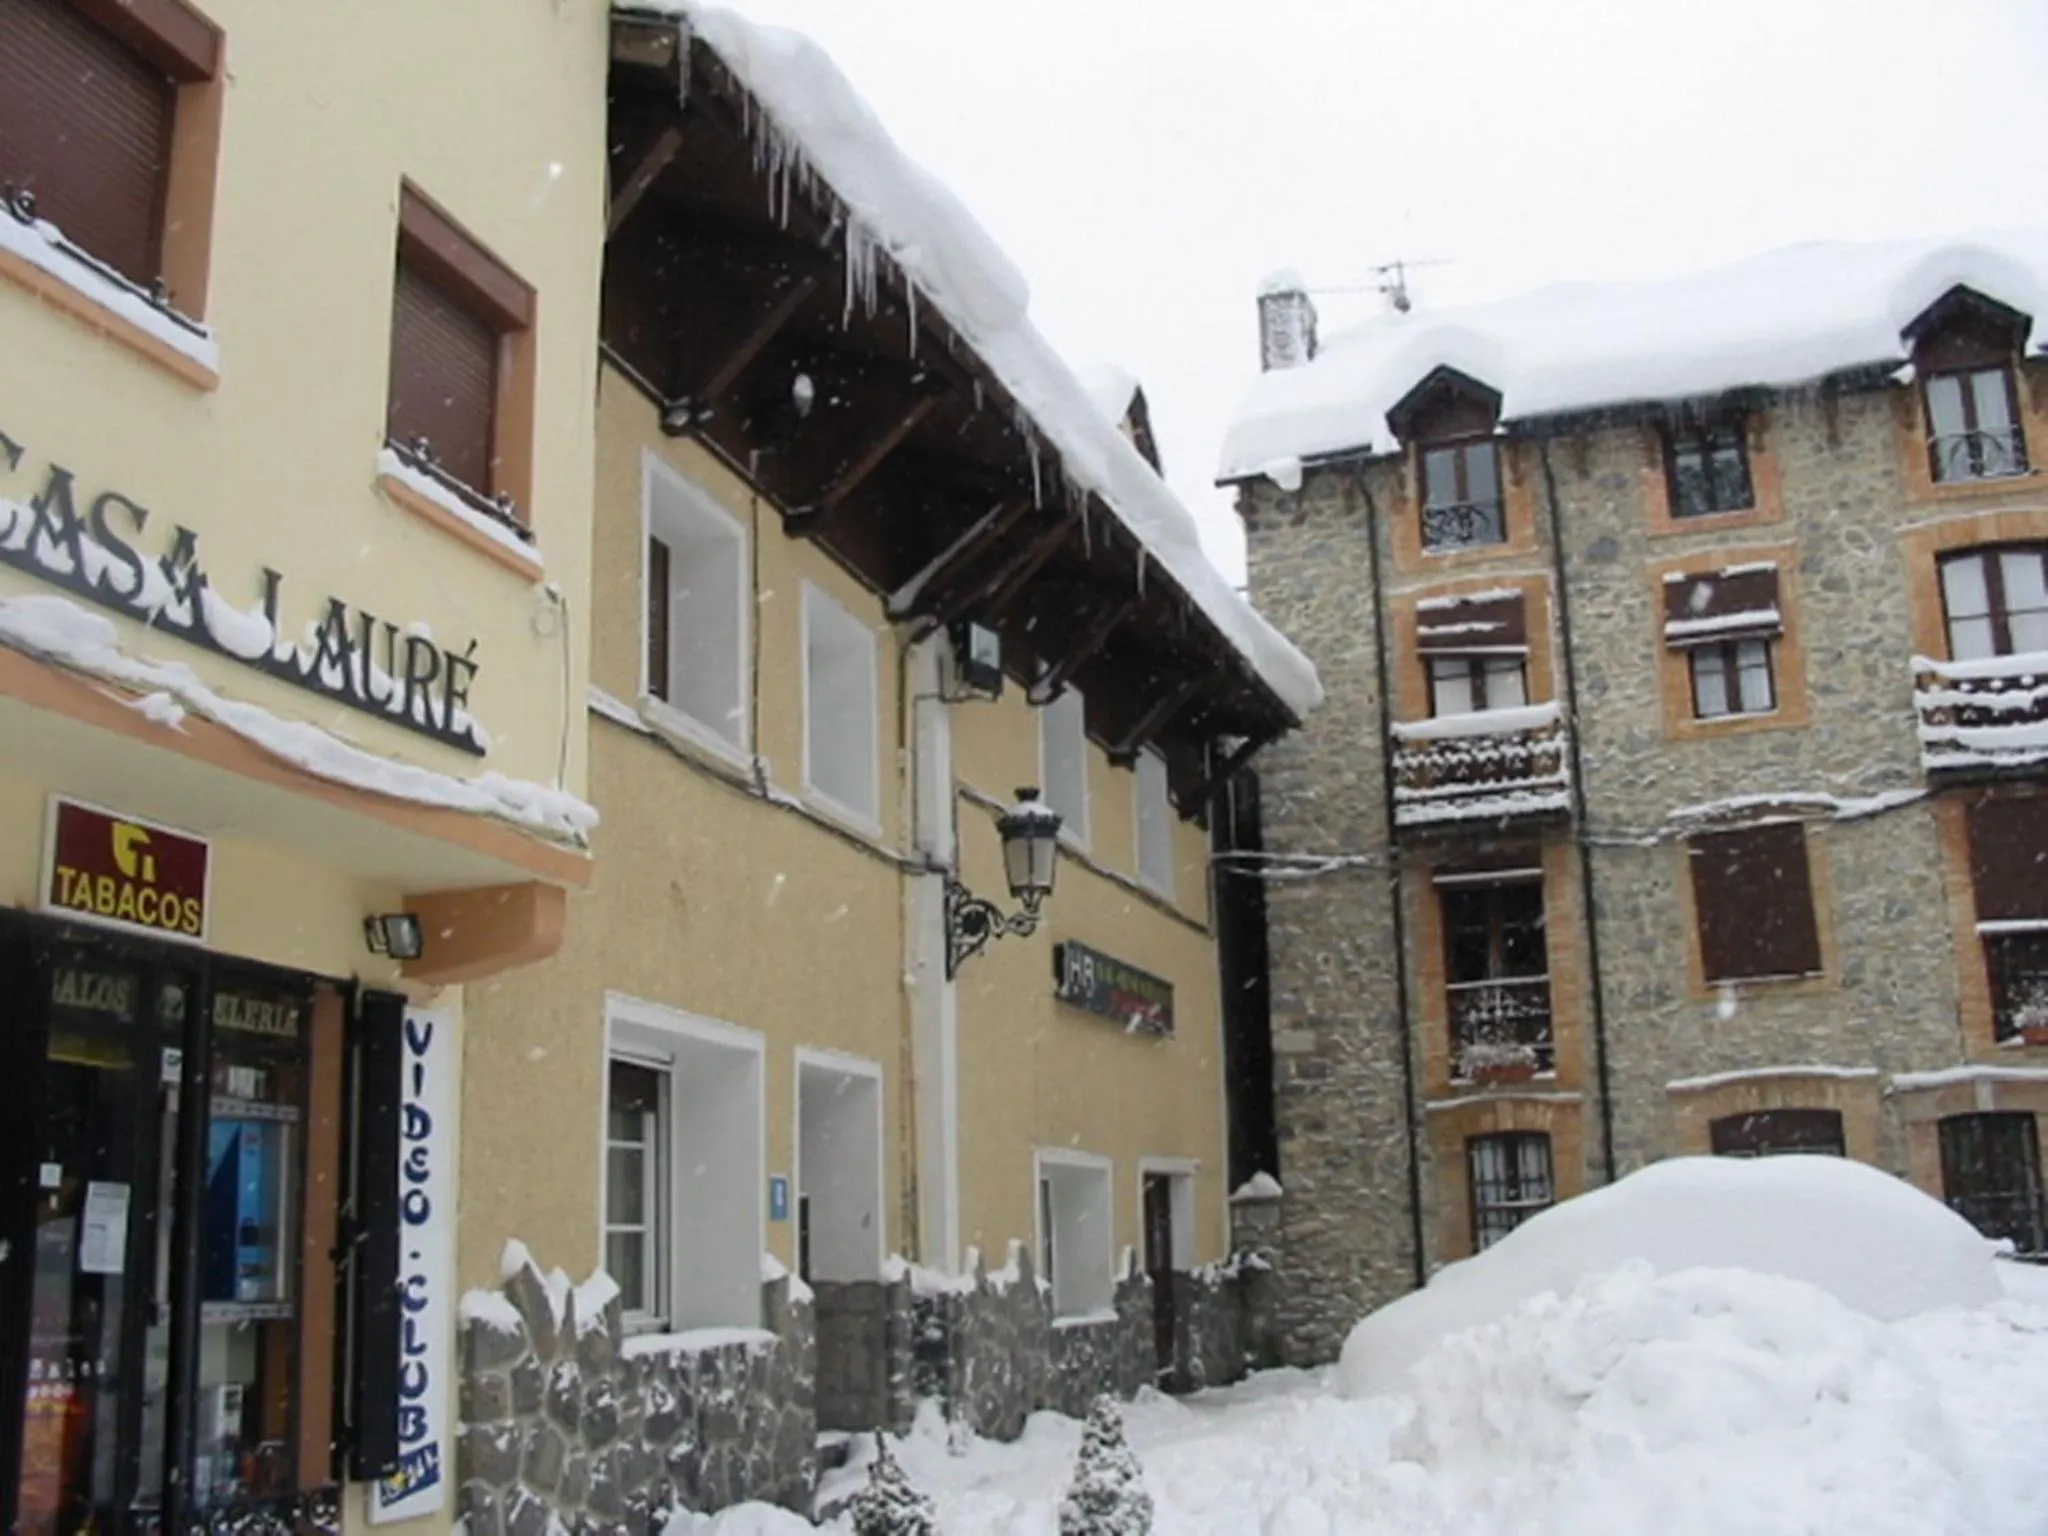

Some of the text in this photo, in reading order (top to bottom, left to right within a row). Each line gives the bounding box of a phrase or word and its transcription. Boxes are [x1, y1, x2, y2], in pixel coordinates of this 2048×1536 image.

[262, 566, 482, 748] LAURÉ
[57, 865, 200, 933] TABACOS
[402, 1018, 433, 1226] VIDEO
[398, 1274, 429, 1443] CLUB
